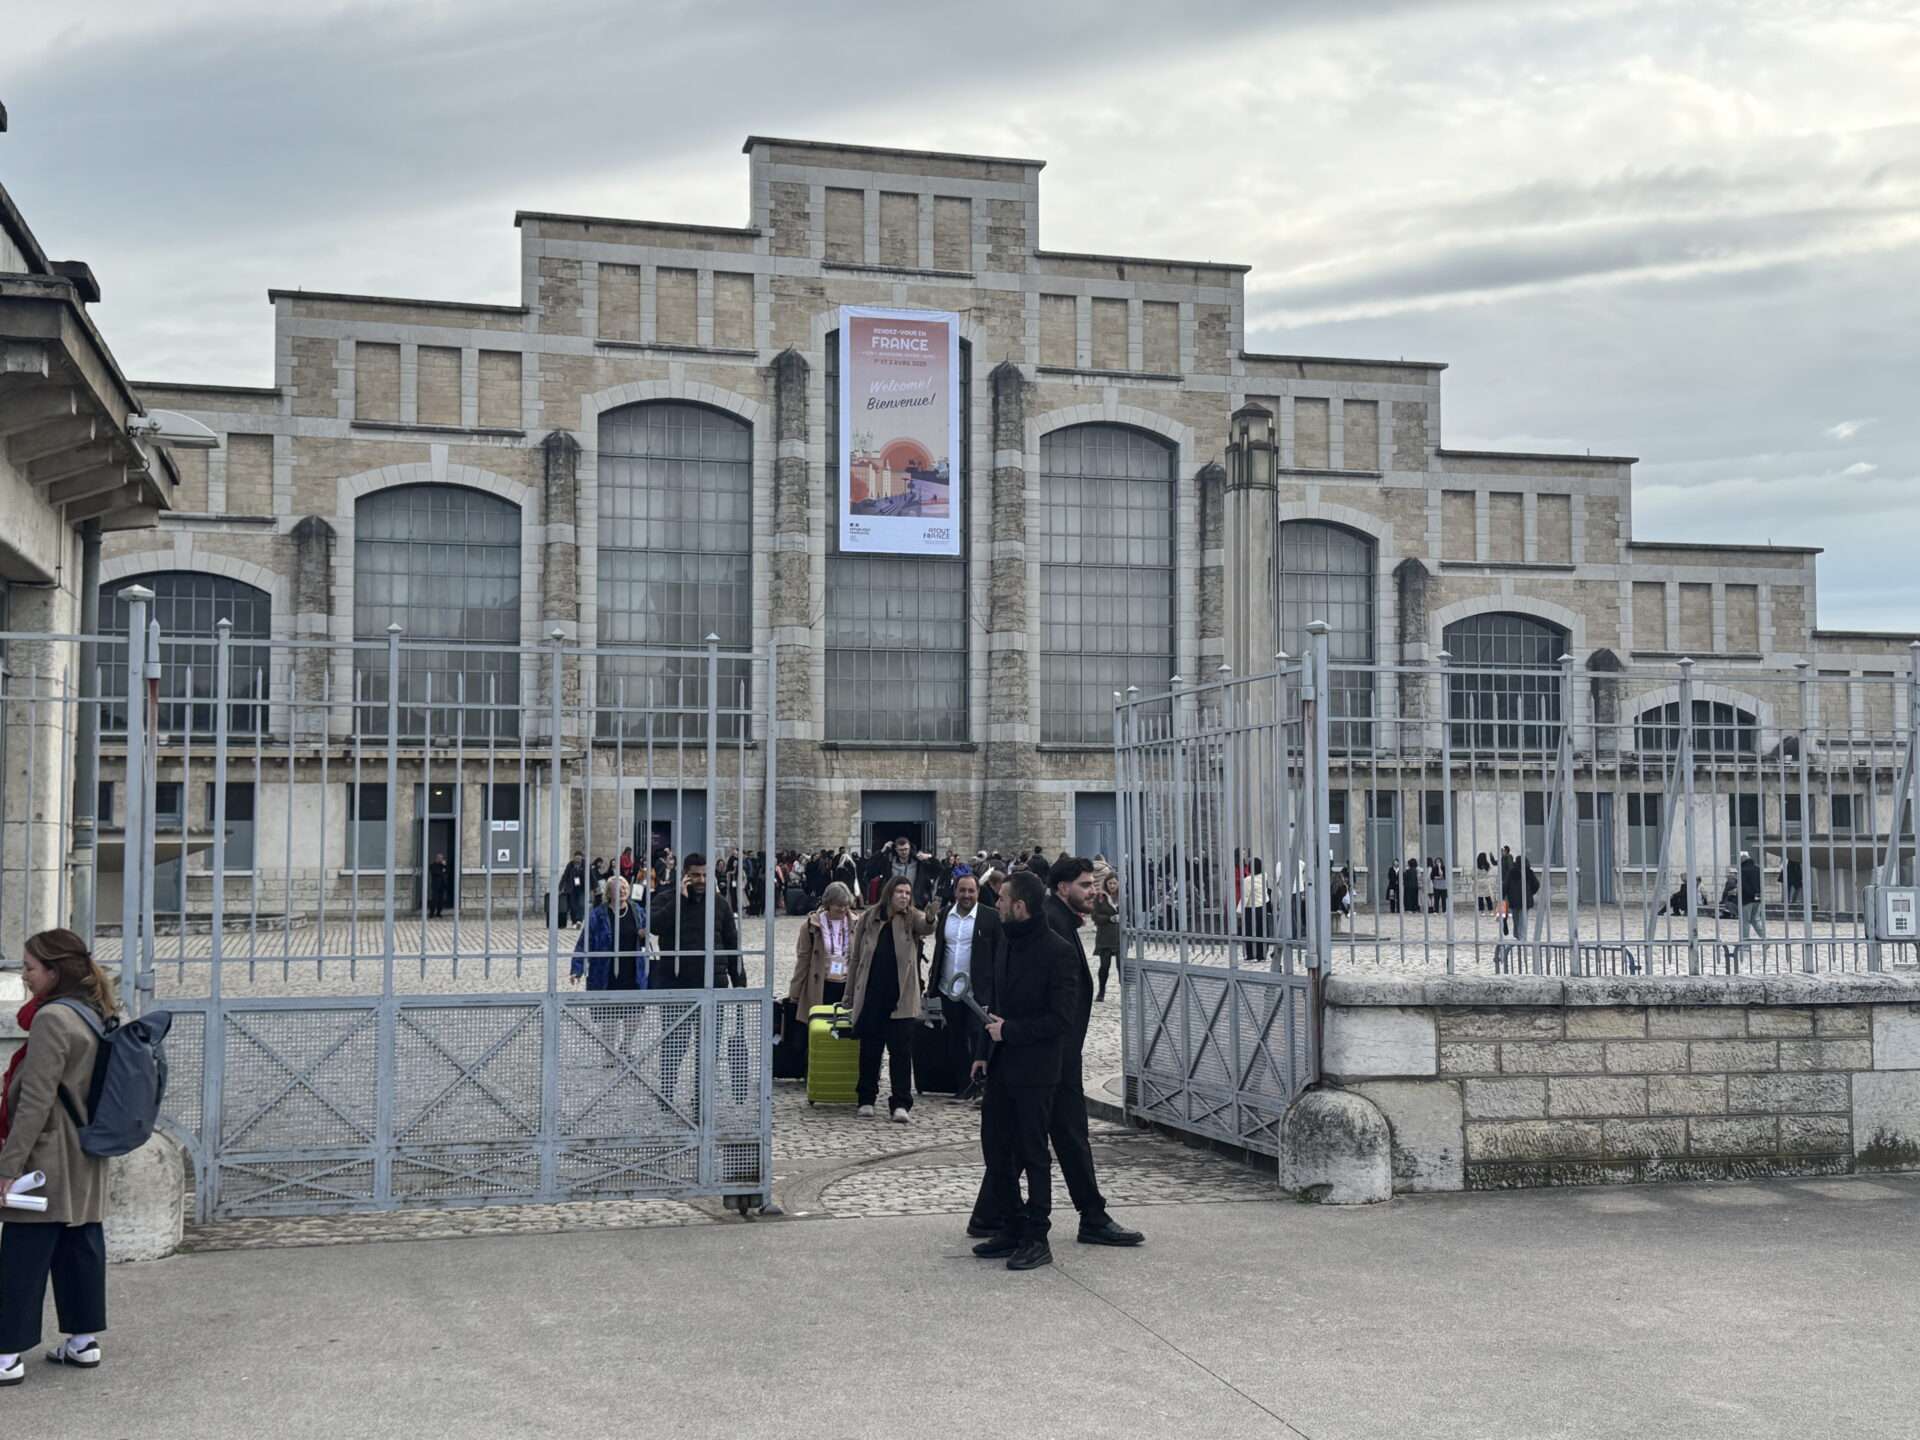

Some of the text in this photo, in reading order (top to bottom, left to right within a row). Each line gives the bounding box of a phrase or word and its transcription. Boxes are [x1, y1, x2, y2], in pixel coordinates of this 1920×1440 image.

[872, 336, 928, 351] FRANCE
[869, 376, 933, 393] Welcome!
[866, 392, 936, 410] Bienvenue!
